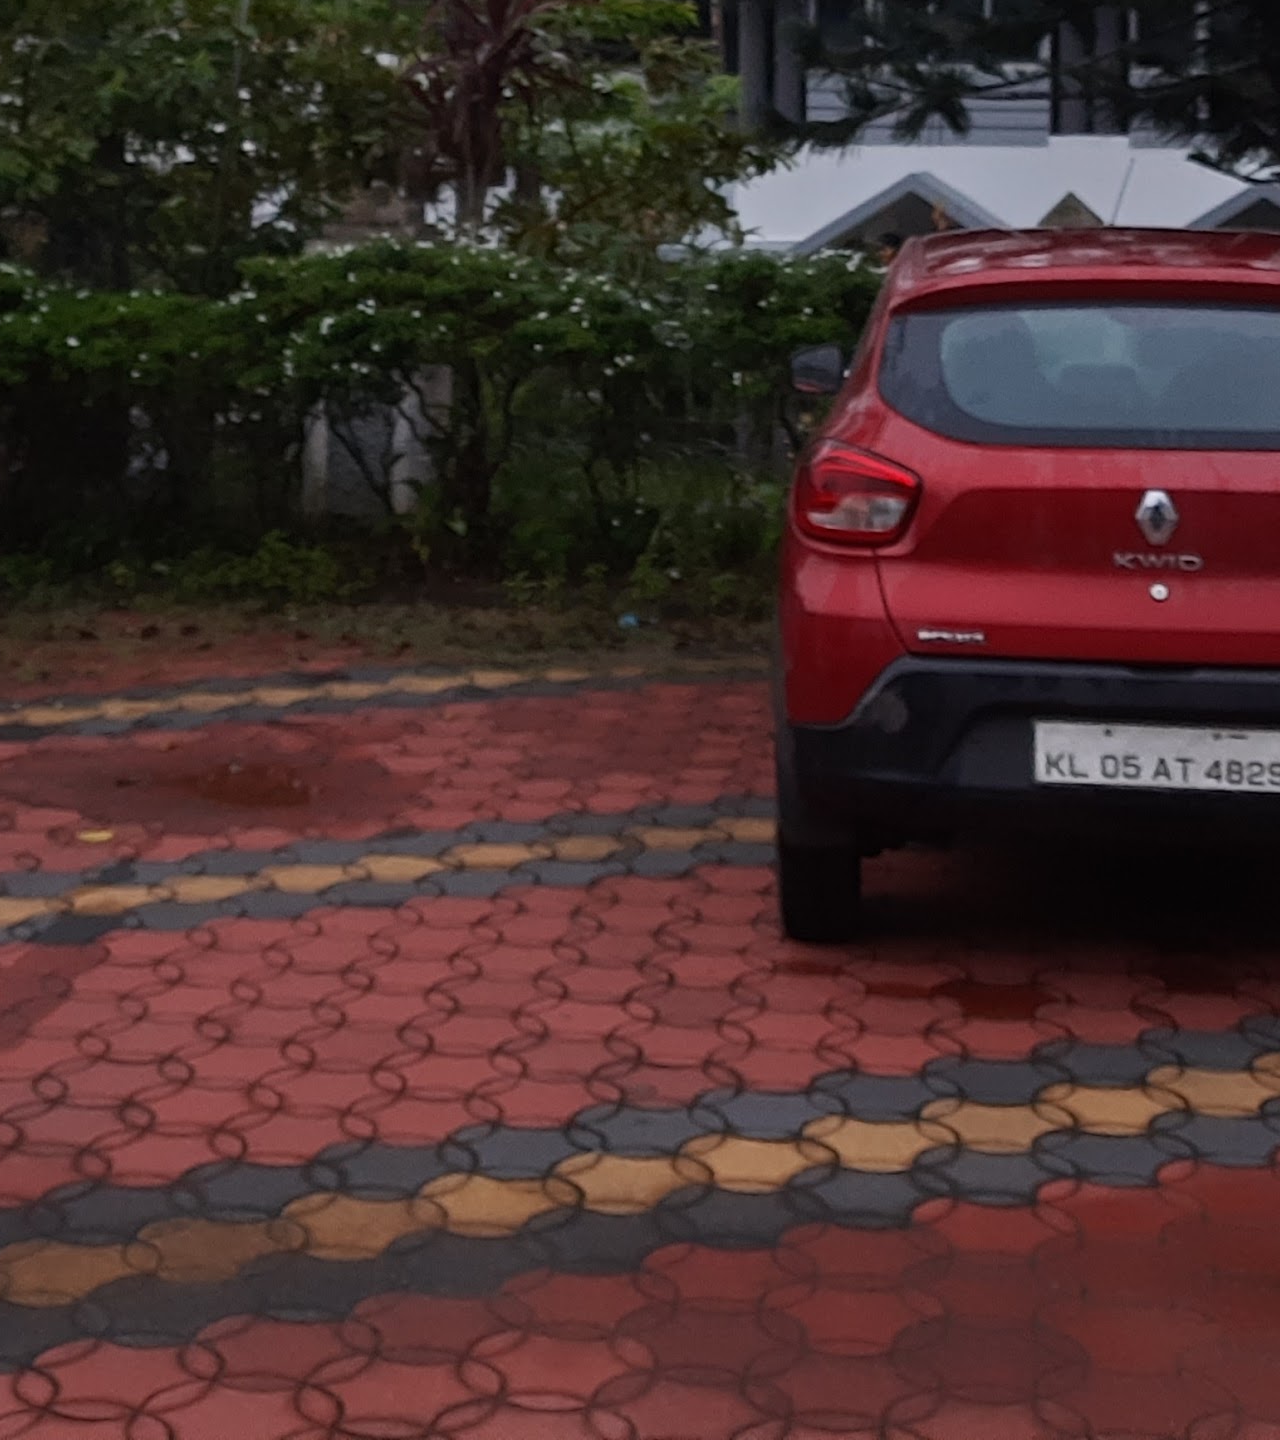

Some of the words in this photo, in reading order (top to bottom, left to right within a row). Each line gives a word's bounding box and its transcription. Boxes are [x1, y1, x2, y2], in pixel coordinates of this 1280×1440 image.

[1113, 553, 1202, 572] KWID
[1045, 751, 1088, 778] KL
[1100, 755, 1141, 780] 05
[1152, 757, 1195, 783] AT
